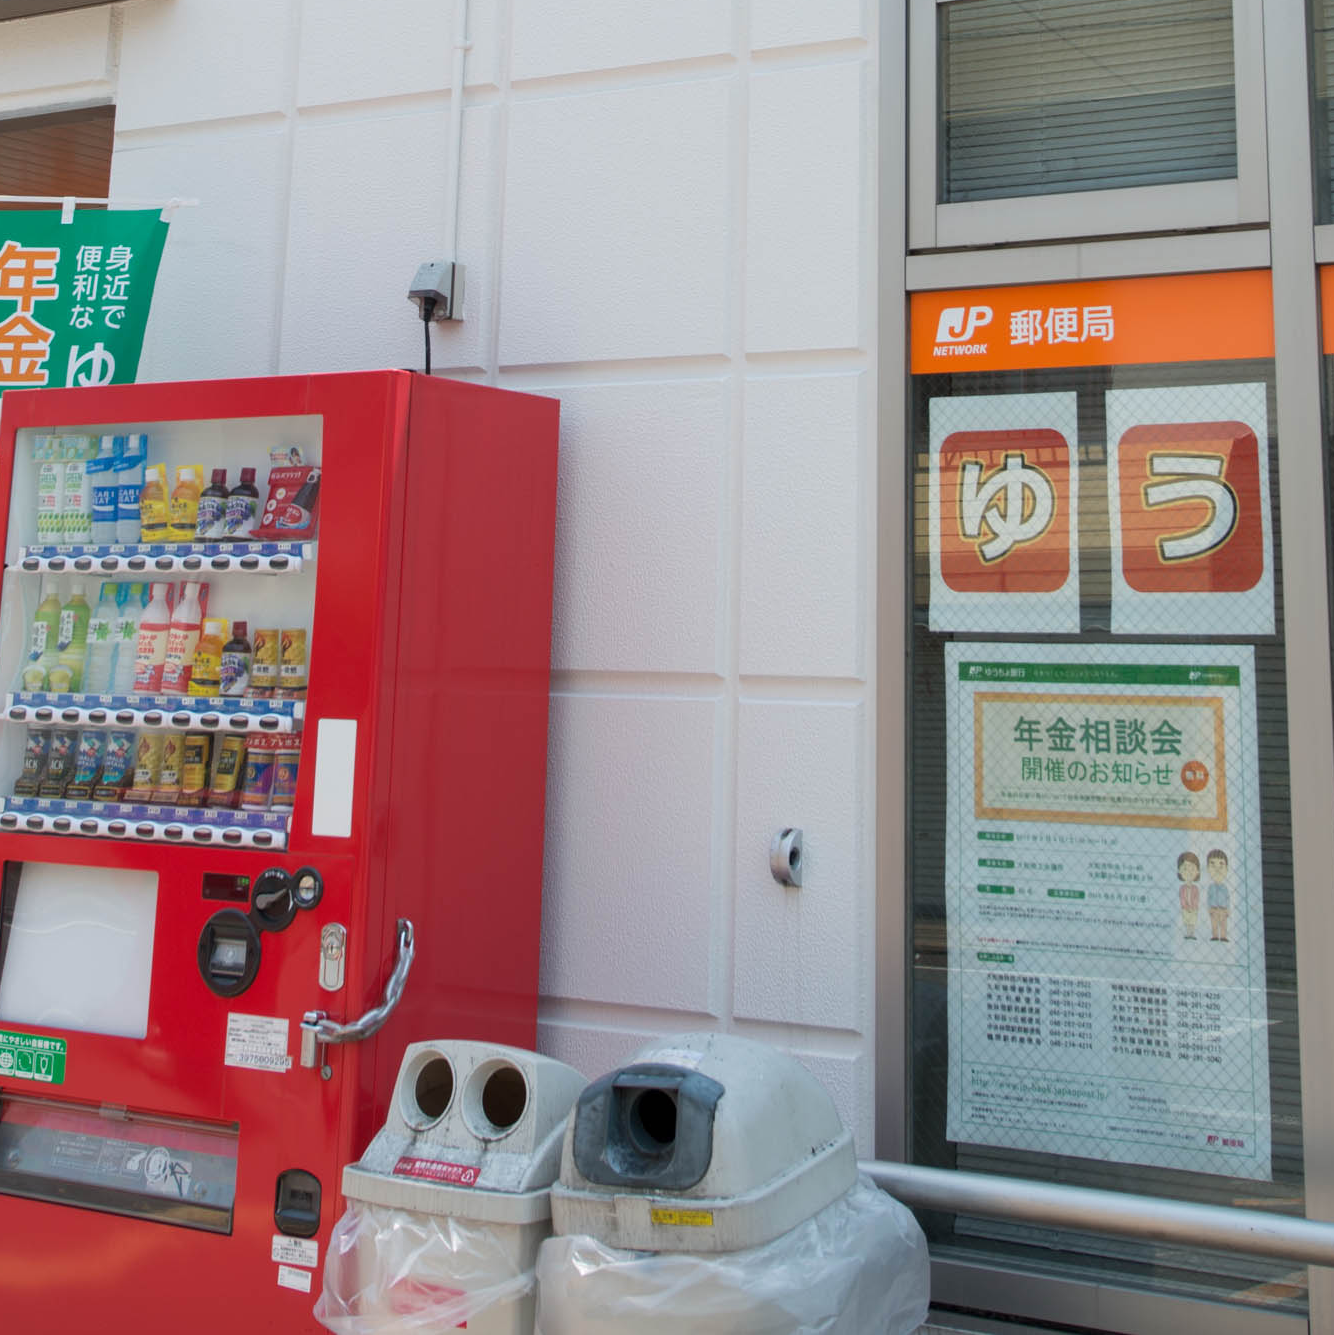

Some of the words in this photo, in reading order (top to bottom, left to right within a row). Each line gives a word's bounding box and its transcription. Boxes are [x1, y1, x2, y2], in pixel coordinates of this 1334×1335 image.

[69, 245, 103, 329] 便利な
[101, 245, 133, 329] 身近で
[935, 306, 993, 343] JP
[1010, 306, 1114, 345] 郵便局
[933, 344, 987, 356] NETWORK
[958, 453, 1056, 563] ゆ
[1143, 451, 1239, 564] う
[1013, 716, 1182, 756] 年金相談会
[1021, 756, 1173, 786] 開催のお知らせ
